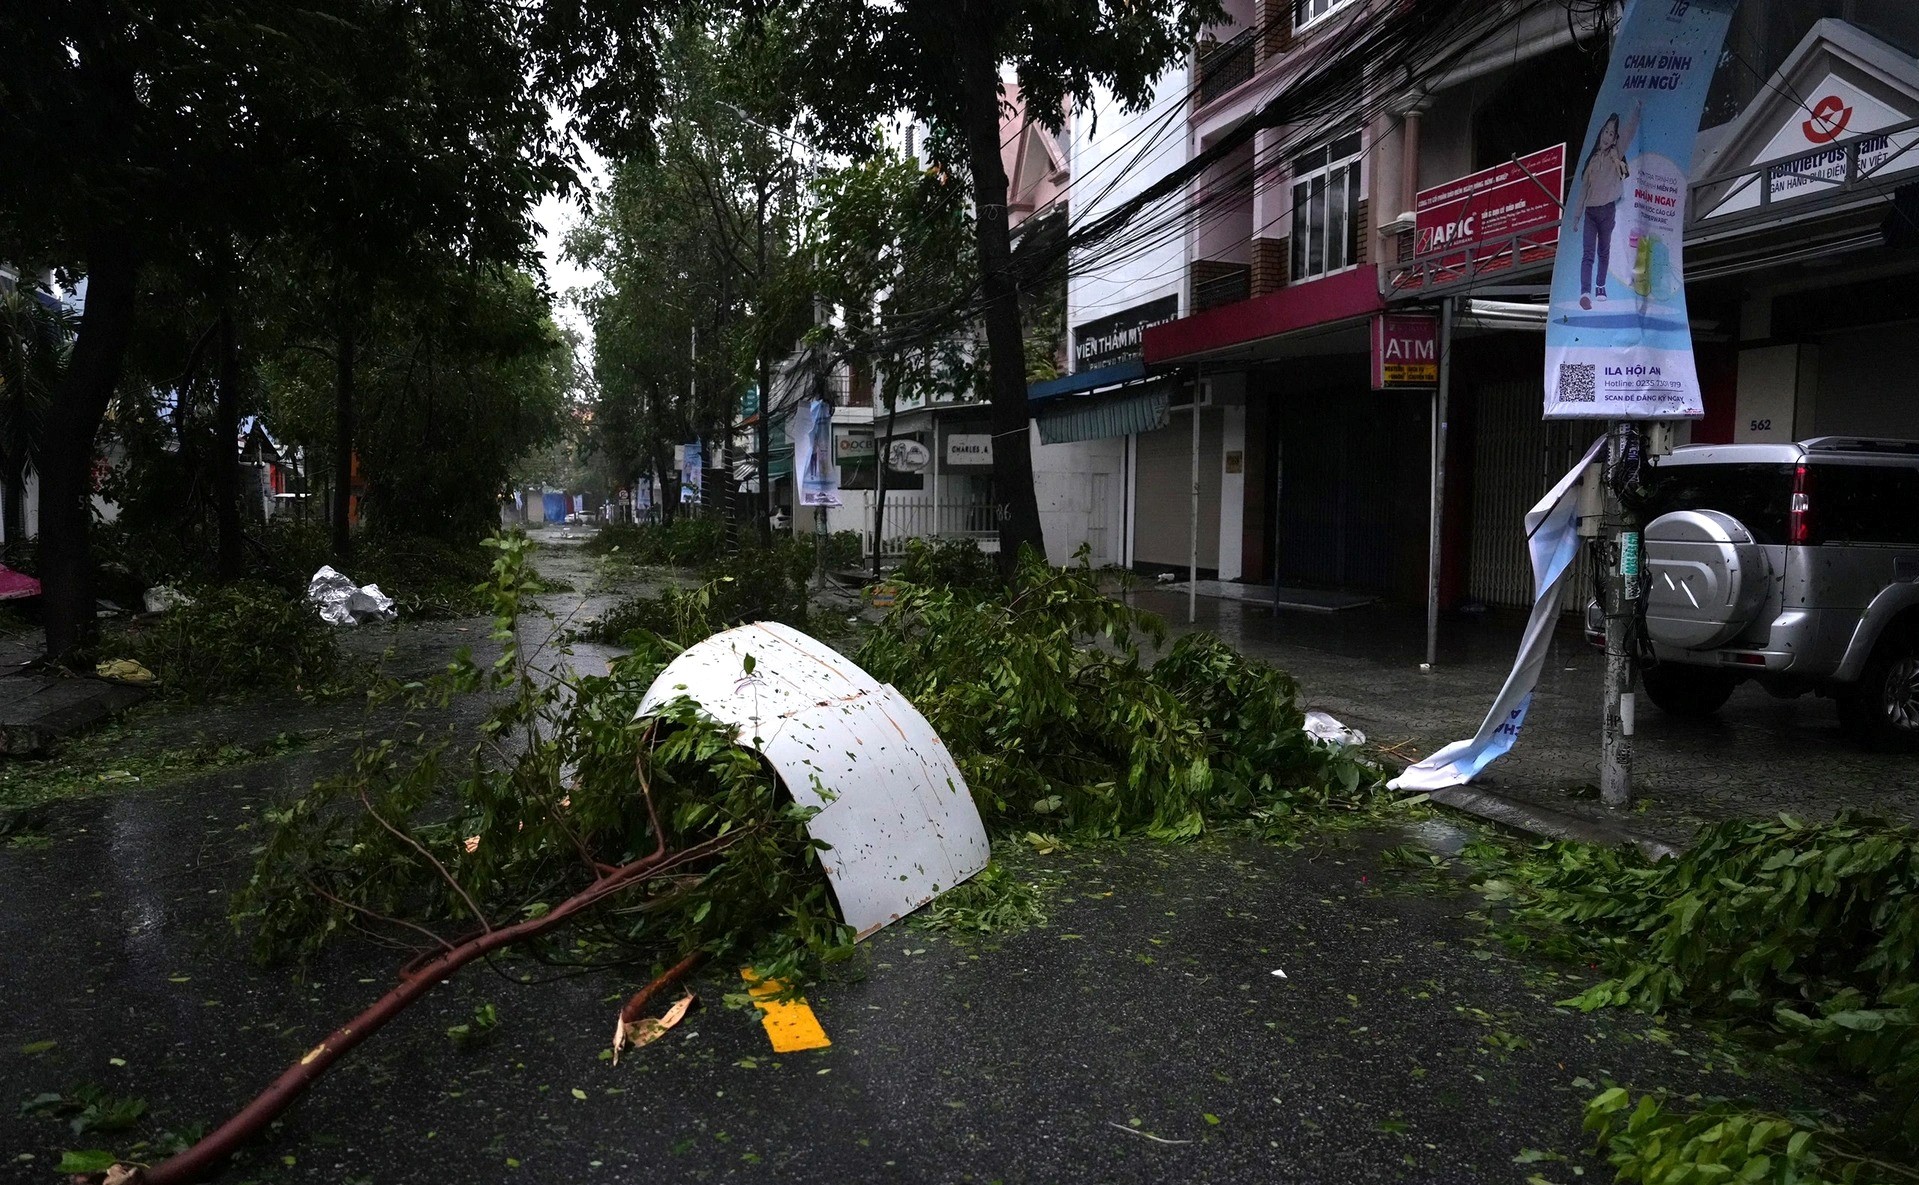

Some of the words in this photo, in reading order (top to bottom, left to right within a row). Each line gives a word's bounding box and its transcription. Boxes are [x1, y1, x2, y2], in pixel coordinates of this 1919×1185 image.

[1624, 55, 1657, 72] CHẠM
[1658, 51, 1692, 70] ĐỈNH
[1622, 75, 1648, 89] ANH
[1648, 73, 1681, 90] NGỮ
[1770, 182, 1784, 193] GÂN
[1655, 195, 1677, 207] NGAY
[1433, 216, 1474, 246] ABIC
[1076, 337, 1097, 361] VIỆN
[1098, 323, 1127, 353] THẨM
[1386, 338, 1434, 359] ATM
[1605, 367, 1622, 375] ILA
[1626, 365, 1645, 377] HỘI
[1649, 367, 1661, 375] AN
[1751, 420, 1771, 431] 562
[851, 440, 873, 450] OCB
[952, 445, 980, 454] CHARLES
